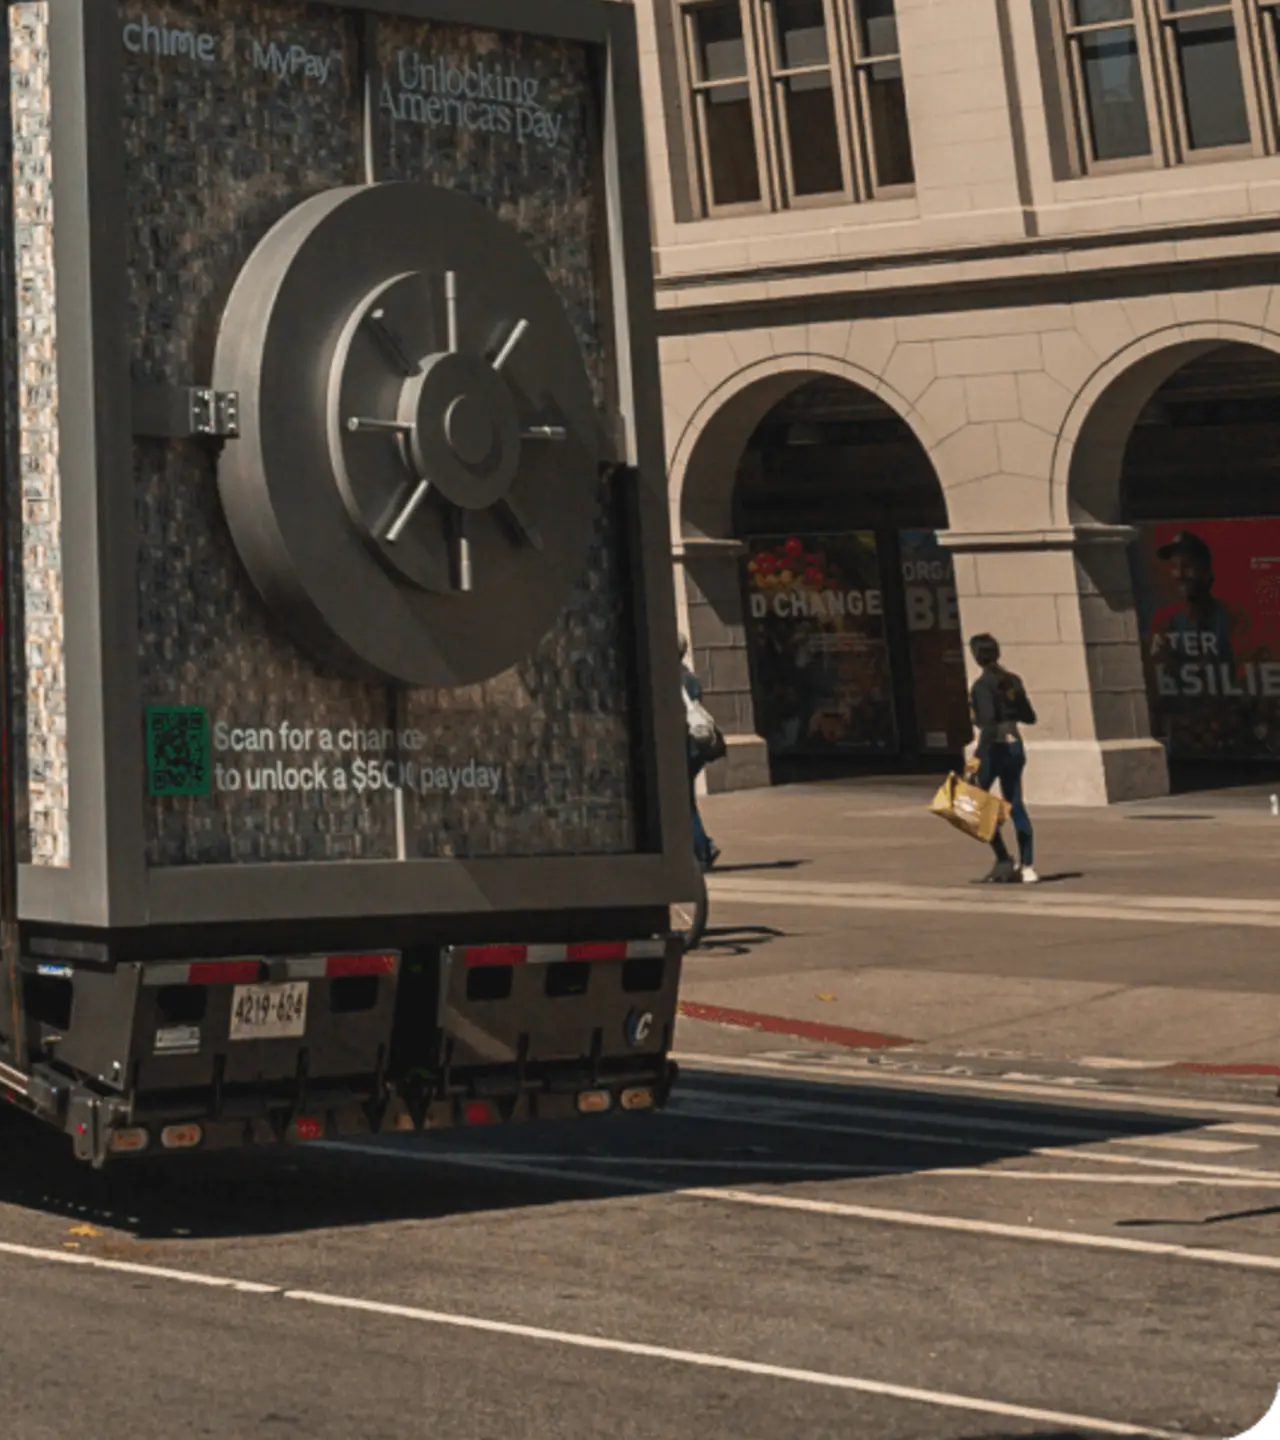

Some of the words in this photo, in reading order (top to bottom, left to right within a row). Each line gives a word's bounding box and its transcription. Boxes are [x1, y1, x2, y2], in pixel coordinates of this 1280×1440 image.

[122, 14, 215, 61] chime
[398, 49, 541, 108] Unlocking
[515, 107, 561, 147] pay
[773, 589, 884, 618] CHANGE
[214, 721, 274, 752] Scan
[280, 721, 312, 751] for
[319, 728, 333, 751] a
[215, 762, 240, 790] to
[245, 760, 328, 790] unlock
[333, 766, 347, 789] a
[420, 758, 502, 794] payday
